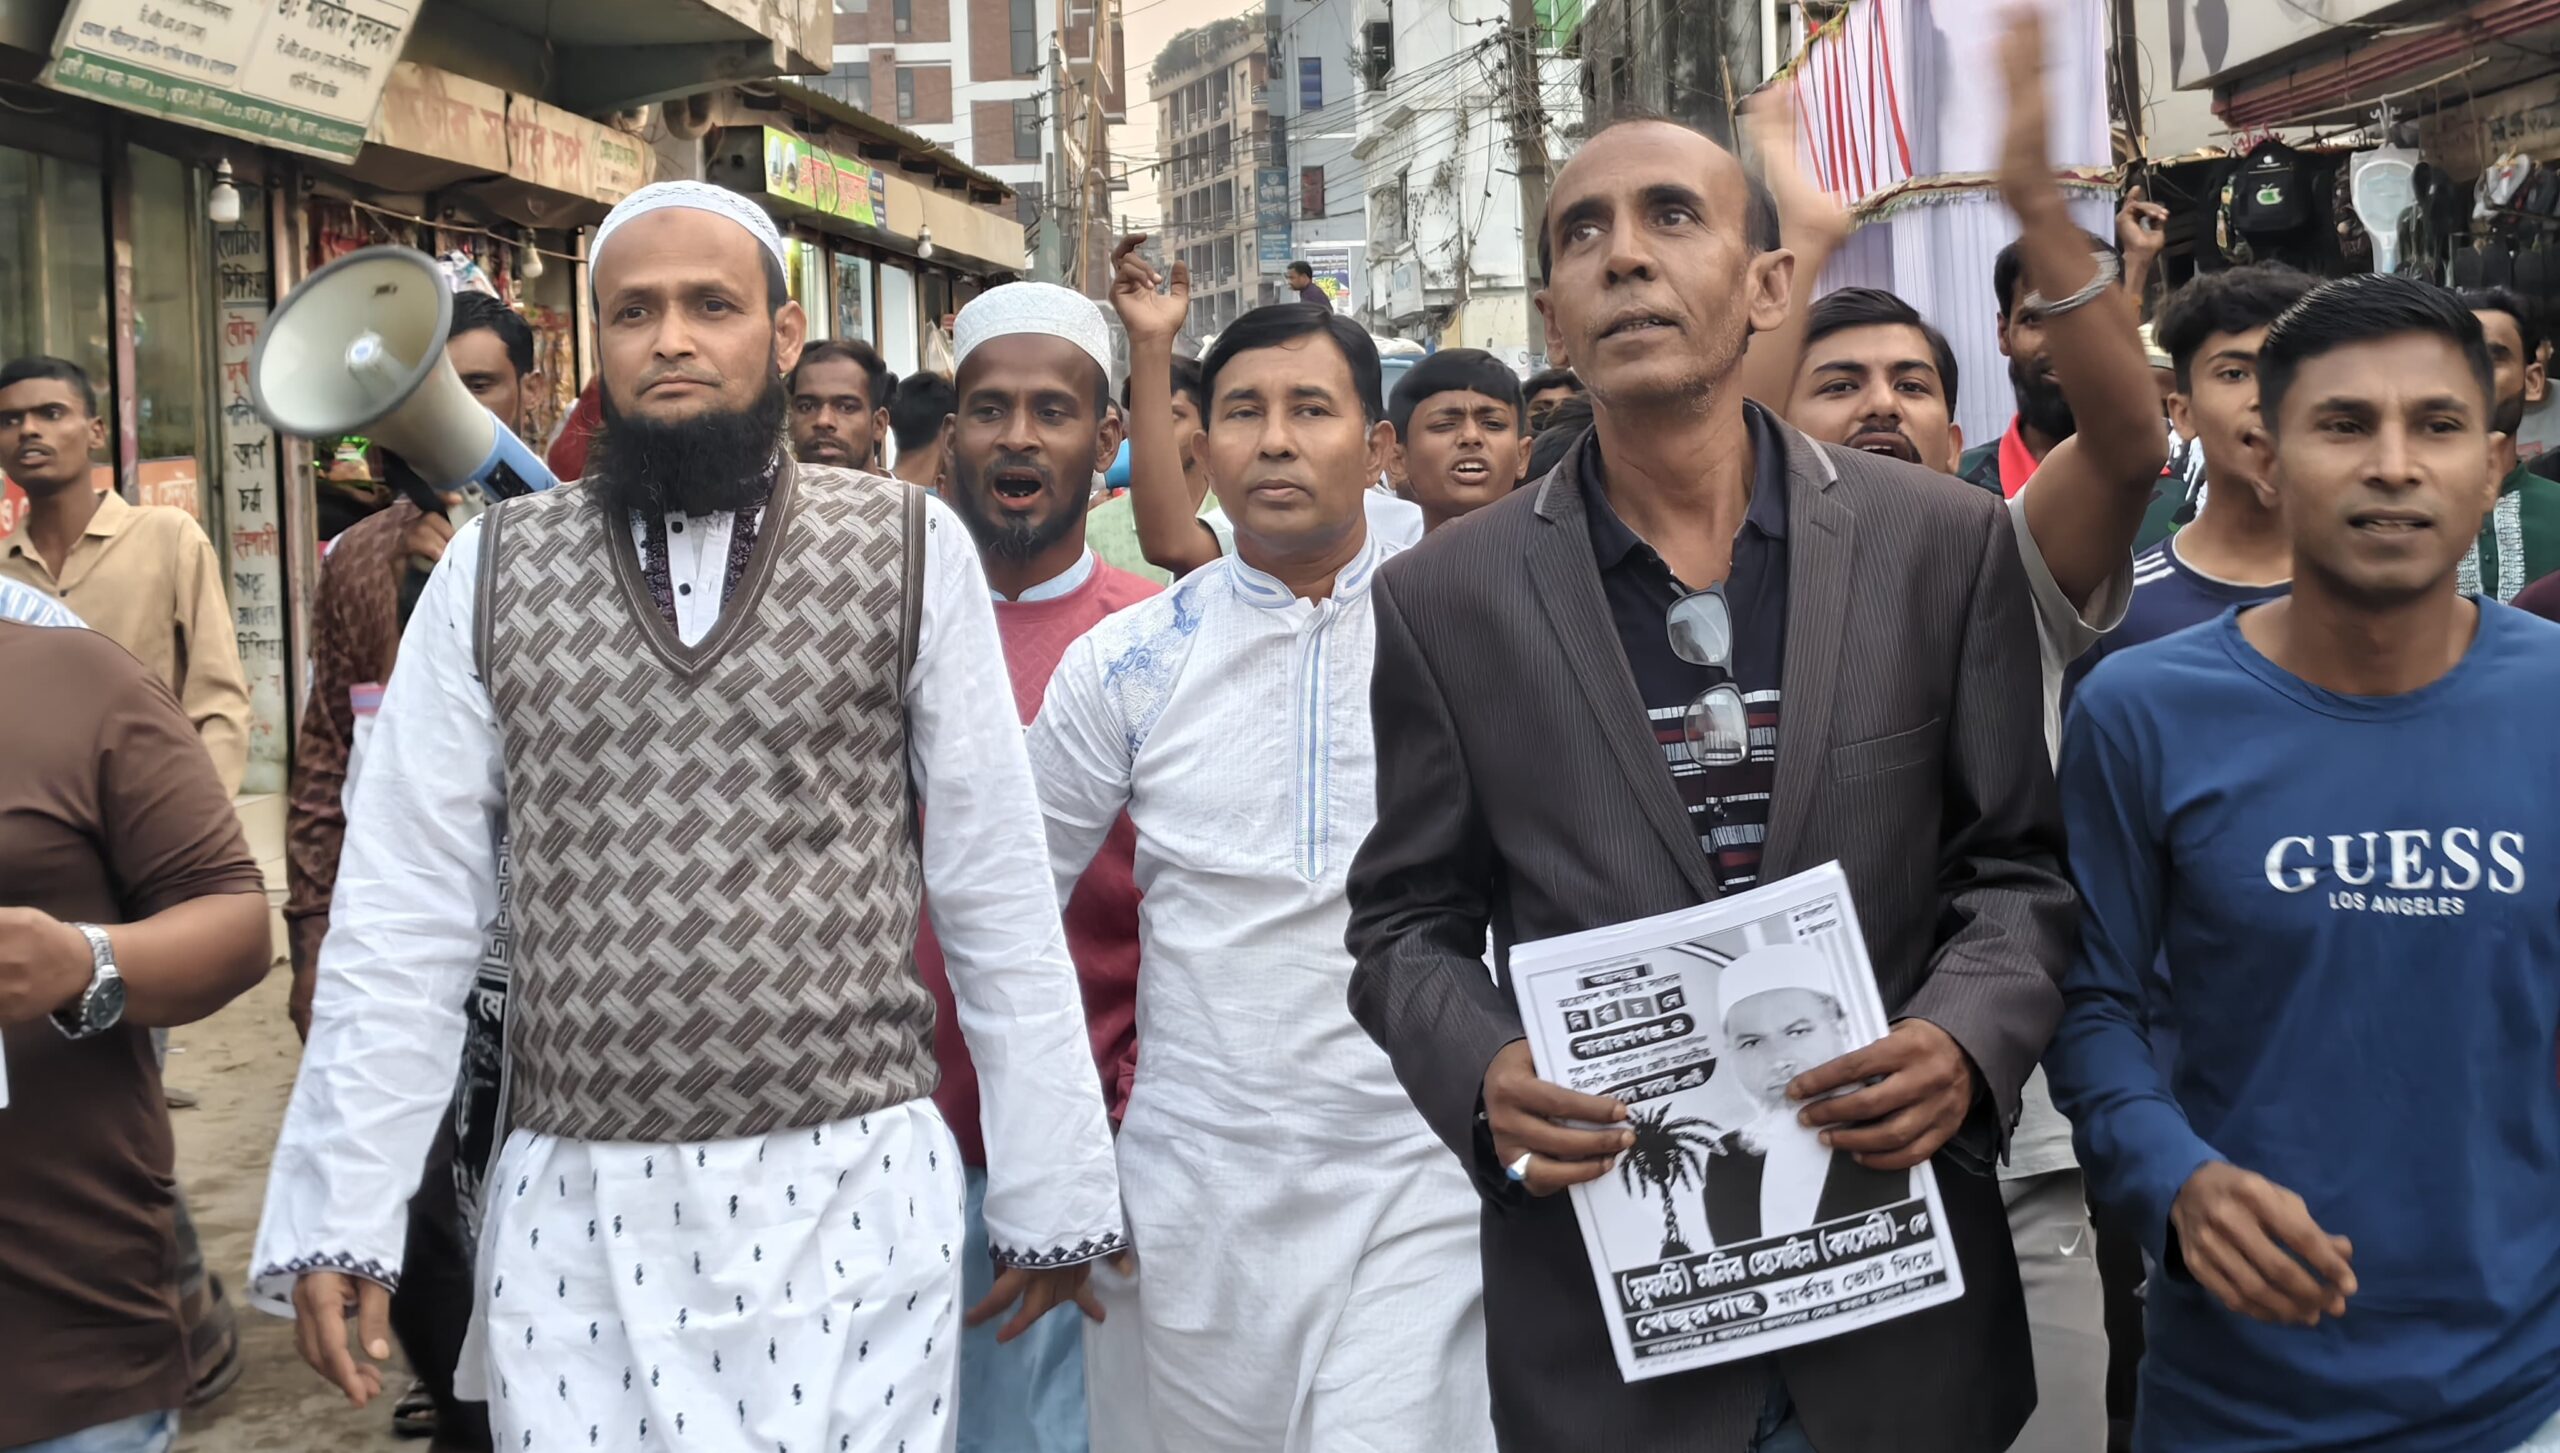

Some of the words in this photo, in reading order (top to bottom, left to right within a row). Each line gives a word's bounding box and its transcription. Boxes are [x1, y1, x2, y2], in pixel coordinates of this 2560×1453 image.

[2264, 826, 2526, 895] GUESS
[2328, 891, 2367, 911] LOS
[2370, 894, 2466, 916] ANGELES
[1693, 1251, 1747, 1289] মনির
[1748, 1236, 1819, 1278] হোসাইন
[1635, 1292, 1764, 1339] খেজুরগাছ
[1775, 1275, 1835, 1308] মার্কায়
[1842, 1260, 1886, 1292] ভোট
[1889, 1250, 1934, 1278] দিয়ে
